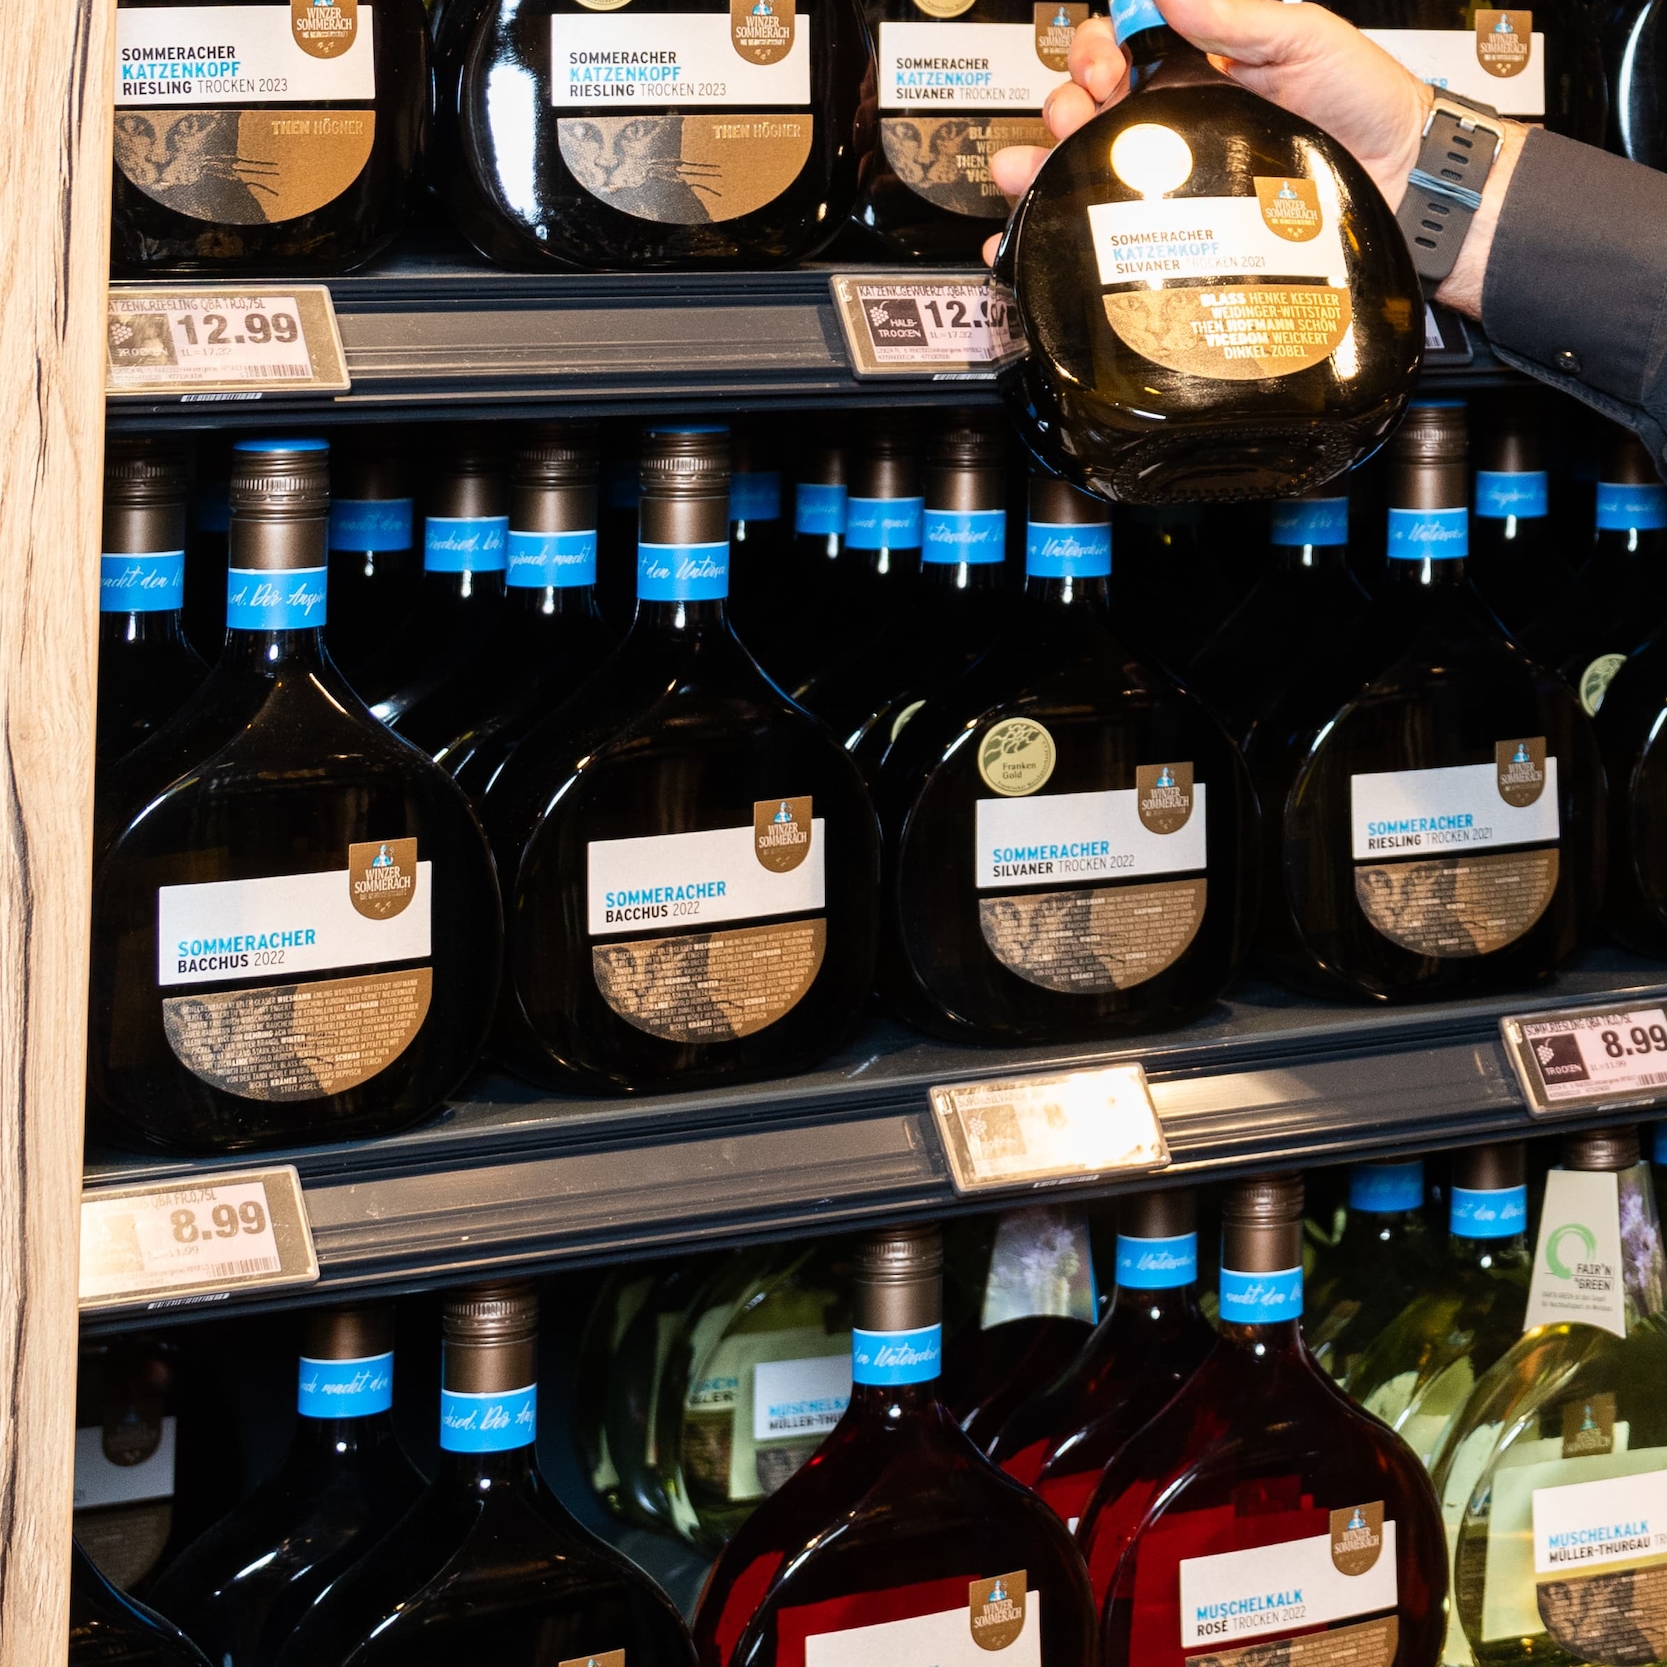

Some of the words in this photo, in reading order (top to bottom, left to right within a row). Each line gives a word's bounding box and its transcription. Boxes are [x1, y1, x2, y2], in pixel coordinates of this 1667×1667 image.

[306, 7, 342, 19] WINZER
[296, 18, 353, 31] SOMMERACH
[745, 16, 780, 27] WINZER
[736, 26, 790, 38] SOMMERACH
[121, 45, 236, 61] SOMMERACHER
[569, 52, 677, 65] SOMMERACHER
[122, 62, 241, 79] KATZENKOPF
[896, 58, 989, 70] SOMMERACHER
[569, 67, 682, 82] KATZENKOPF
[896, 72, 992, 86] KATZENKOPF
[122, 80, 193, 96] RIESLING
[197, 79, 256, 94] TROCKEN
[259, 78, 289, 92] 2023
[569, 83, 635, 97] RIESLING
[640, 83, 695, 96] TROCKEN
[698, 82, 727, 96] 2023
[896, 88, 954, 100] SILVANER
[959, 88, 1006, 100] TROCKEN
[1008, 88, 1030, 100] 2021
[271, 120, 310, 136] THEN
[313, 117, 364, 135] HÖGNER
[1111, 229, 1214, 246] SOMMERACHER
[1113, 243, 1219, 259] KATZENKOPF
[1116, 259, 1180, 274] SILVANER
[1247, 292, 1288, 305] HENKE
[1290, 292, 1339, 306] KESTLER
[1211, 306, 1342, 320] WEIDINGER-WITTSTADT
[176, 313, 298, 346] 12.99
[1226, 319, 1296, 332] HOFMANN
[1297, 317, 1337, 332] SCHÖN
[1205, 333, 1267, 346] VICEDOM
[1268, 332, 1328, 345] WEICKERT
[1223, 345, 1265, 358] DINKEL
[1002, 762, 1036, 771] Franken
[767, 821, 798, 834] WINZER
[1367, 814, 1474, 836] SOMMERACHER
[758, 831, 807, 849] SOMMERACH
[1368, 836, 1421, 851] RIESLING
[1425, 831, 1469, 846] TROCKEN
[993, 840, 1110, 863] SOMMERACHER
[365, 867, 401, 880] WINZER
[993, 860, 1054, 878] SILVANER
[1057, 856, 1107, 874] TROCKEN
[1110, 853, 1135, 870] 2022
[354, 876, 411, 893] SOMMERACH
[605, 880, 727, 908] SOMMERACHER
[605, 905, 668, 924] BACCHUS
[672, 901, 700, 918] 2022
[177, 929, 316, 958] SOMMERACHER
[177, 954, 249, 974] BACCHUS
[253, 950, 285, 967] 2022
[345, 1000, 379, 1012] KAUFMANN
[169, 1201, 267, 1244] 8.99
[1548, 1520, 1649, 1548] MUSCHELKALK
[1548, 1536, 1651, 1564] MÜLLER-THURGAU
[1196, 1589, 1304, 1621] MUSCHELKALK
[1197, 1616, 1228, 1636] ROSÉ
[1231, 1612, 1279, 1632] TROCKEN
